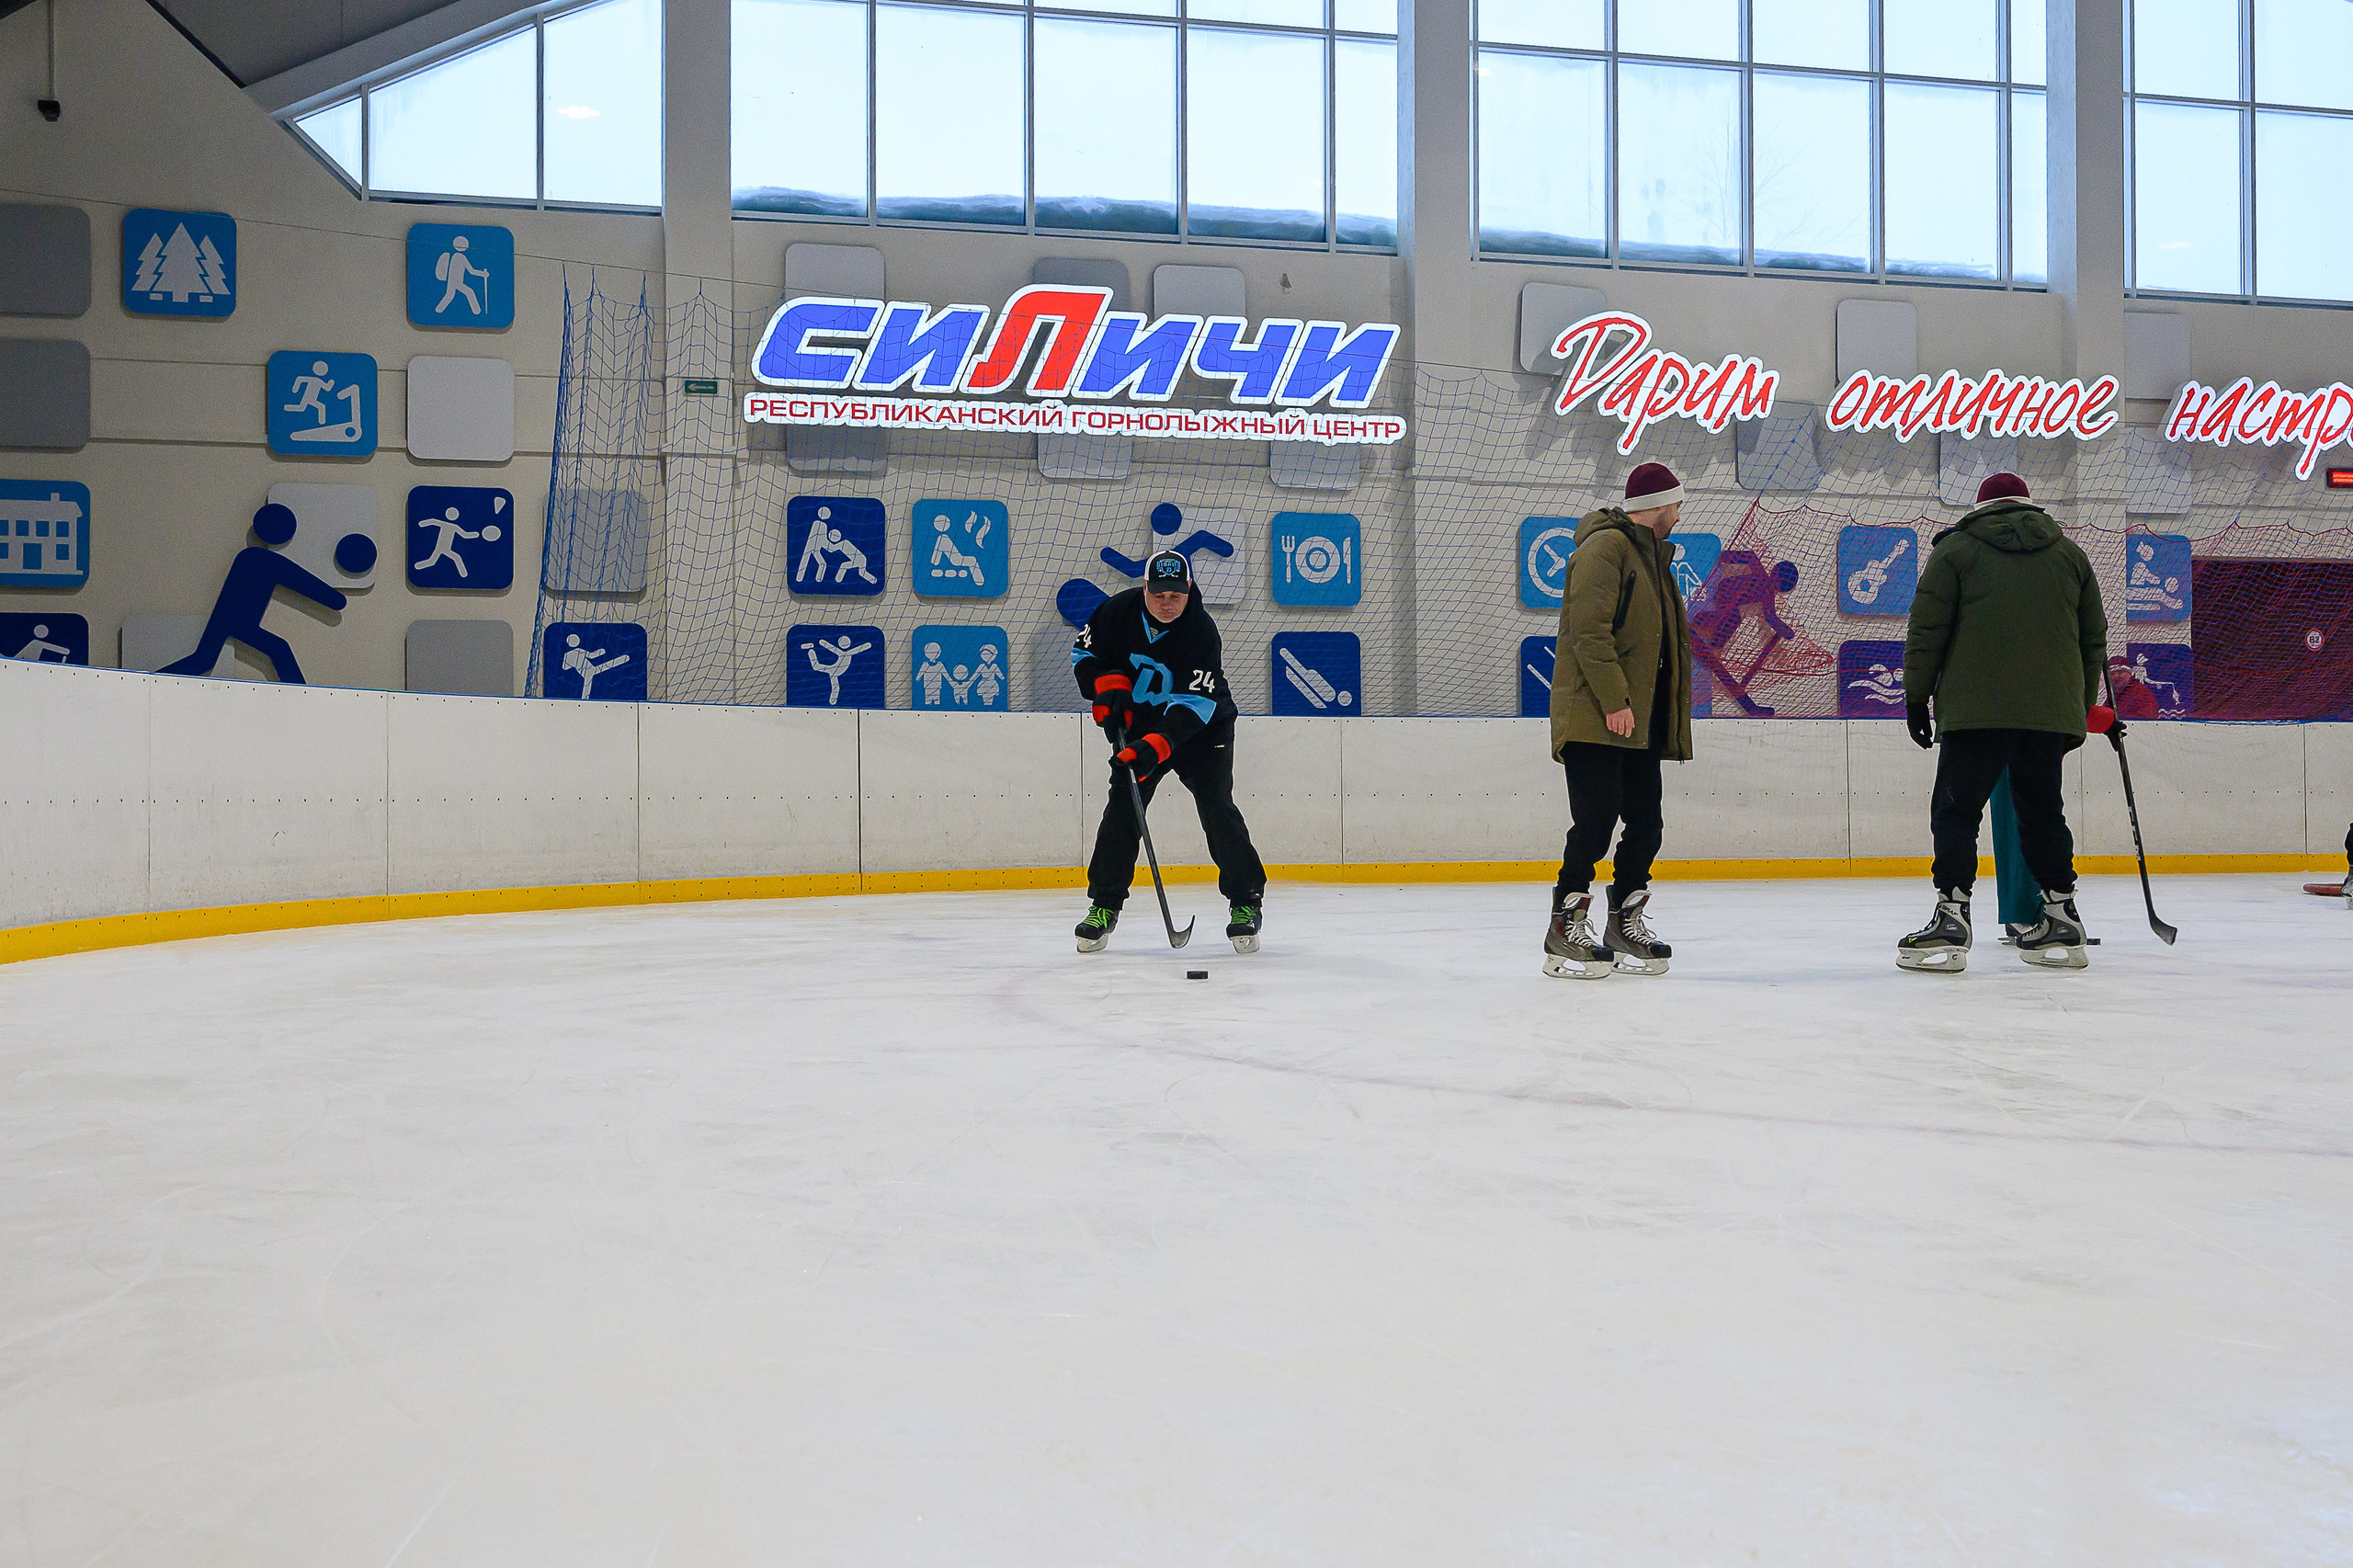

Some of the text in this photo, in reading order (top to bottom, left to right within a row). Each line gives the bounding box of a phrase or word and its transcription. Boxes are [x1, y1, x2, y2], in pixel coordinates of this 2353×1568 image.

[1555, 315, 2353, 475] Дарим отличное настр
[749, 398, 1402, 439] РЕСПУБЛИКАНСКИЙ ГОРНОЛЫЖНЫЙ ЦЕНТР
[1189, 669, 1215, 693] 24
